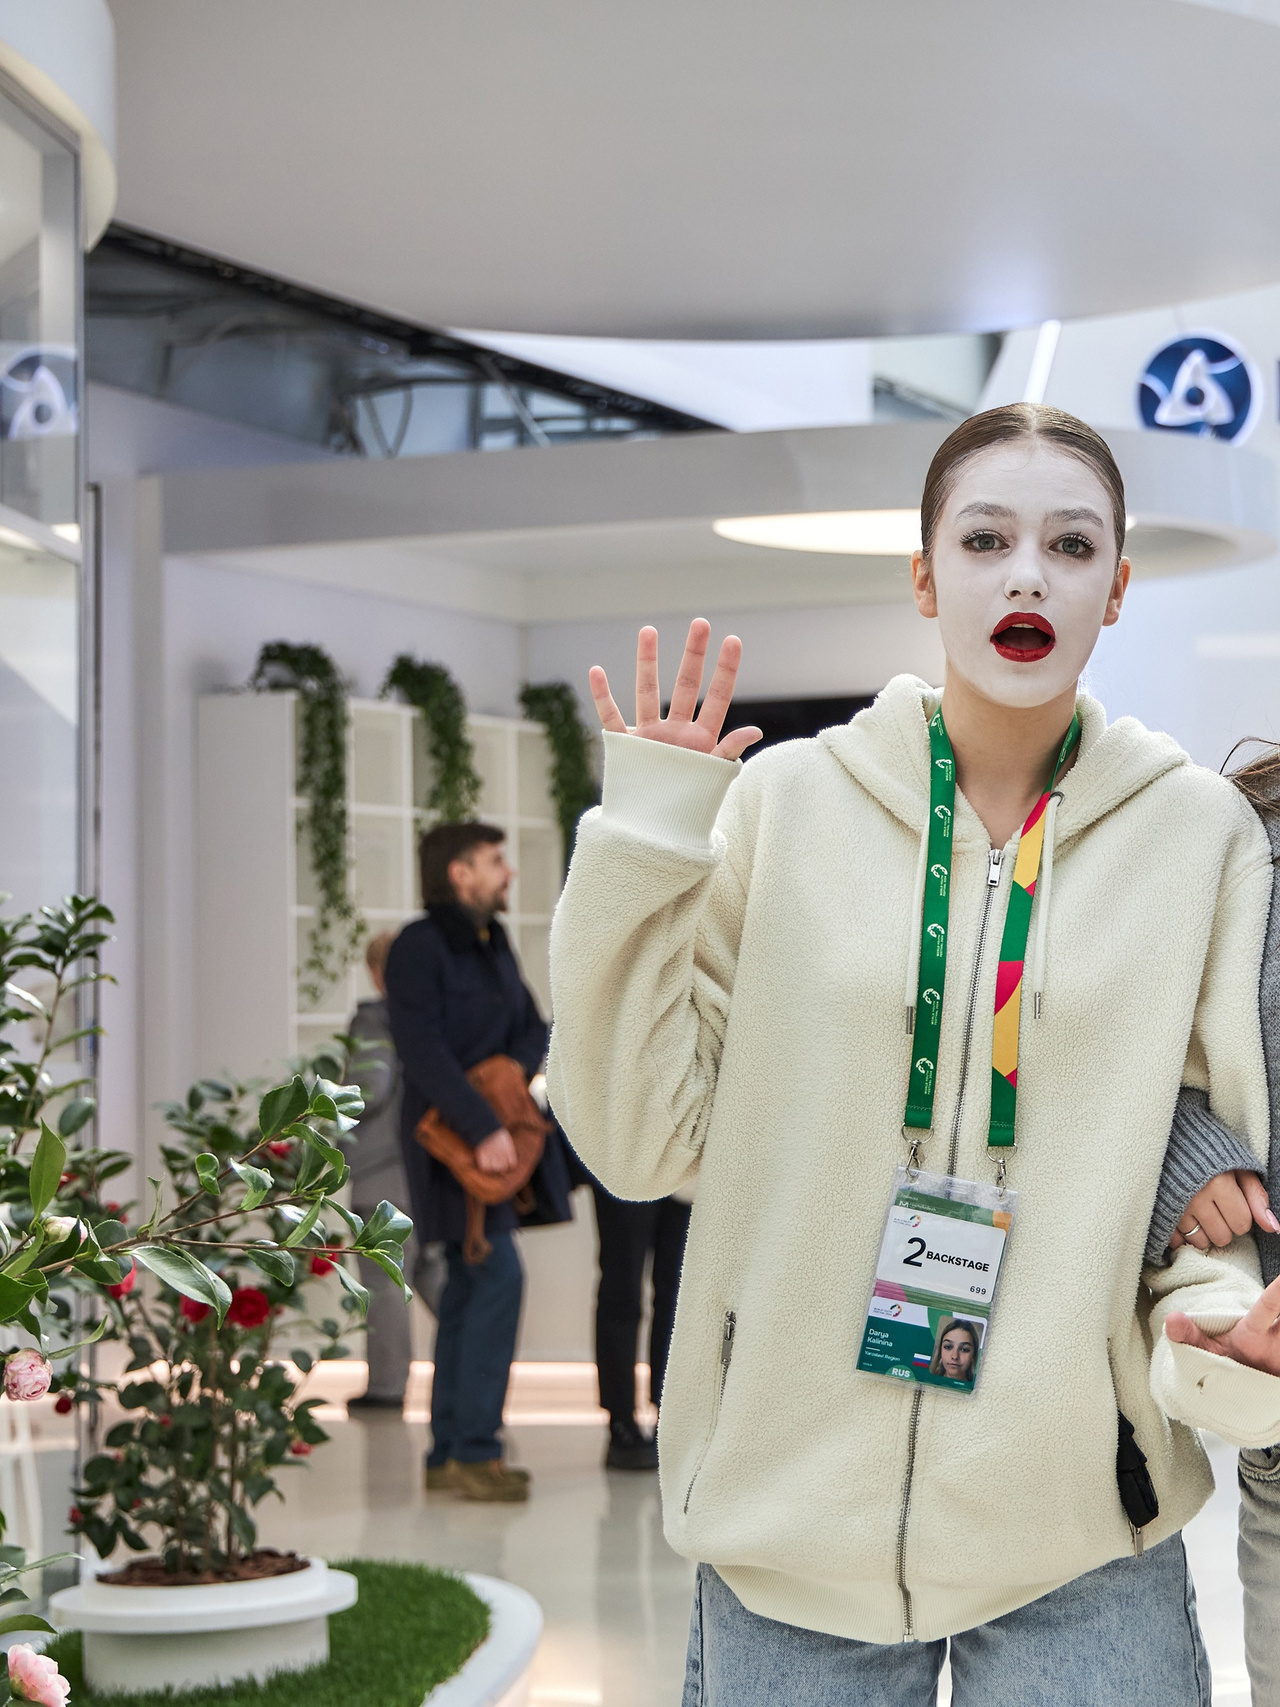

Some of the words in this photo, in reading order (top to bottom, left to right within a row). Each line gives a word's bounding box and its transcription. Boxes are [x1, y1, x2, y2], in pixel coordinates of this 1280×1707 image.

[903, 1236, 927, 1268] 2
[926, 1250, 990, 1273] BACKSTAGE
[969, 1285, 987, 1296] 699
[868, 1328, 890, 1339] Darya
[867, 1336, 894, 1347] Kalinina
[891, 1367, 911, 1378] RUS
